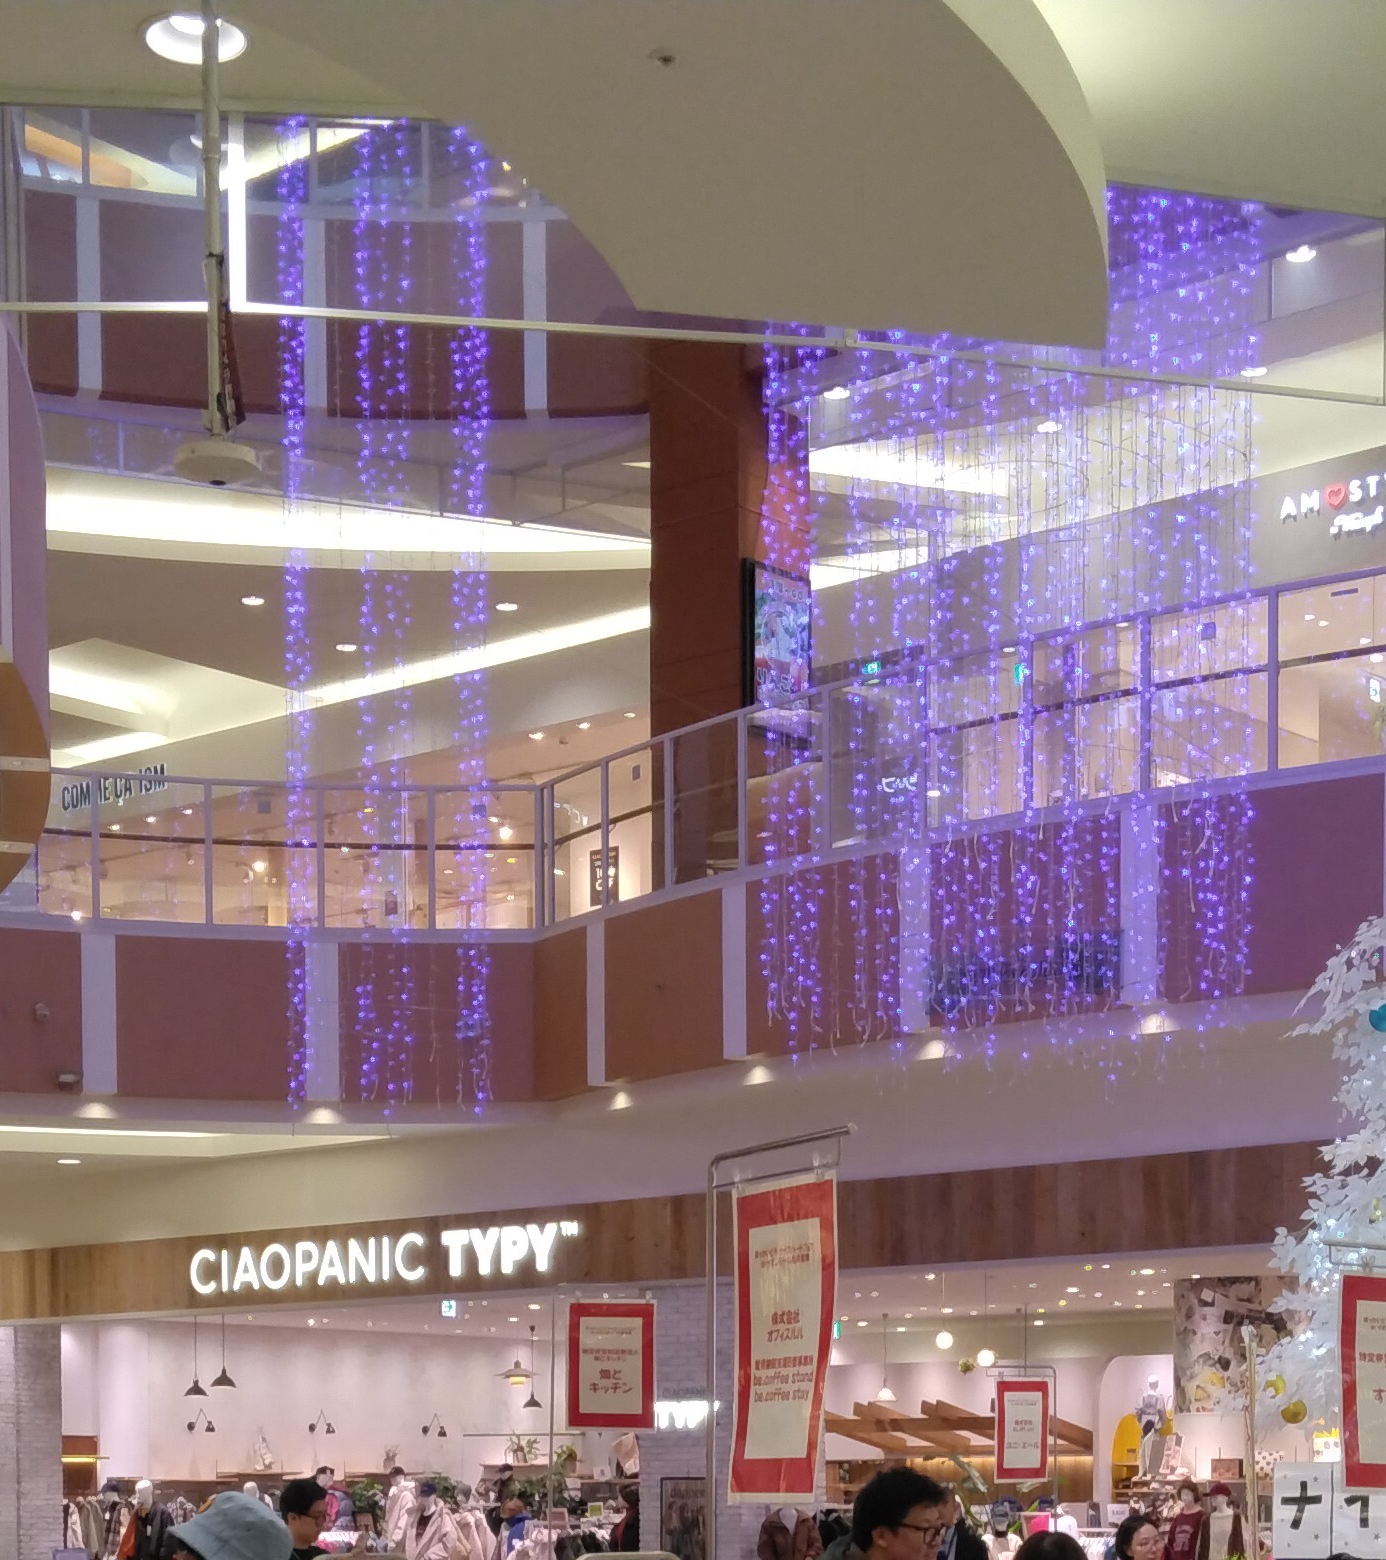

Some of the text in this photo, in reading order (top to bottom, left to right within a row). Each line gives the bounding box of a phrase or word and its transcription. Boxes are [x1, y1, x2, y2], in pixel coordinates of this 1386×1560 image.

[190, 1232, 427, 1295] CIAOPANIC
[589, 1381, 633, 1394] キッチン
